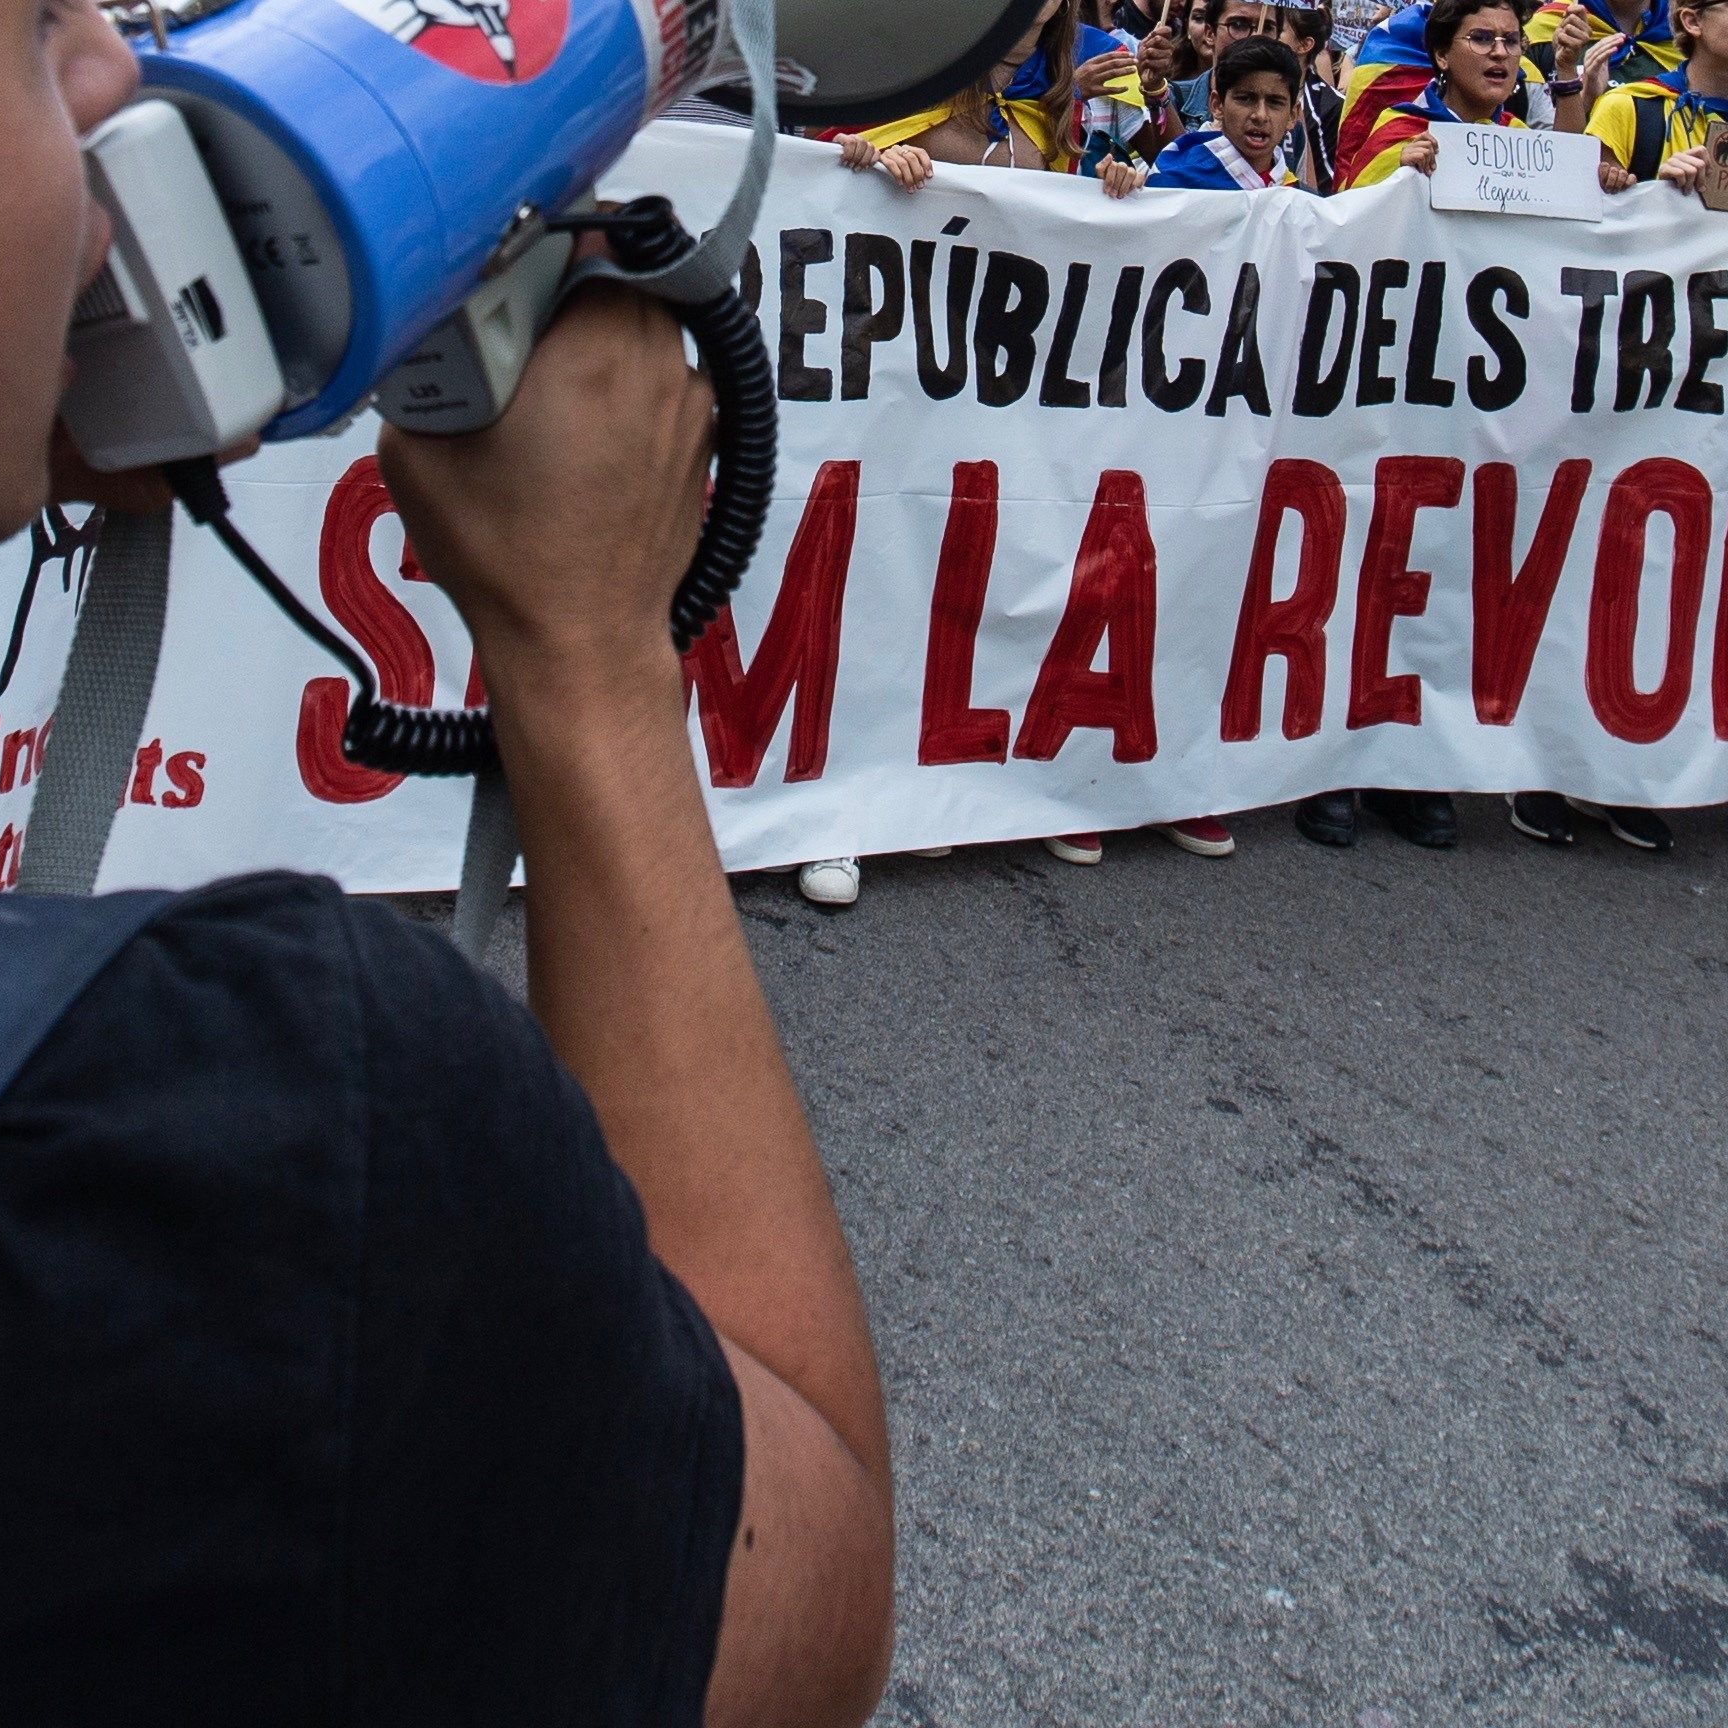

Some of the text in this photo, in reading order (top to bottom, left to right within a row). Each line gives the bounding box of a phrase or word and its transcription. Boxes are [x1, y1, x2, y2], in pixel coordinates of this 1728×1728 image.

[1466, 131, 1554, 172] SEDICIÓS
[1291, 258, 1531, 419] DELS
[296, 455, 862, 804] SM
[917, 458, 1158, 767] LA
